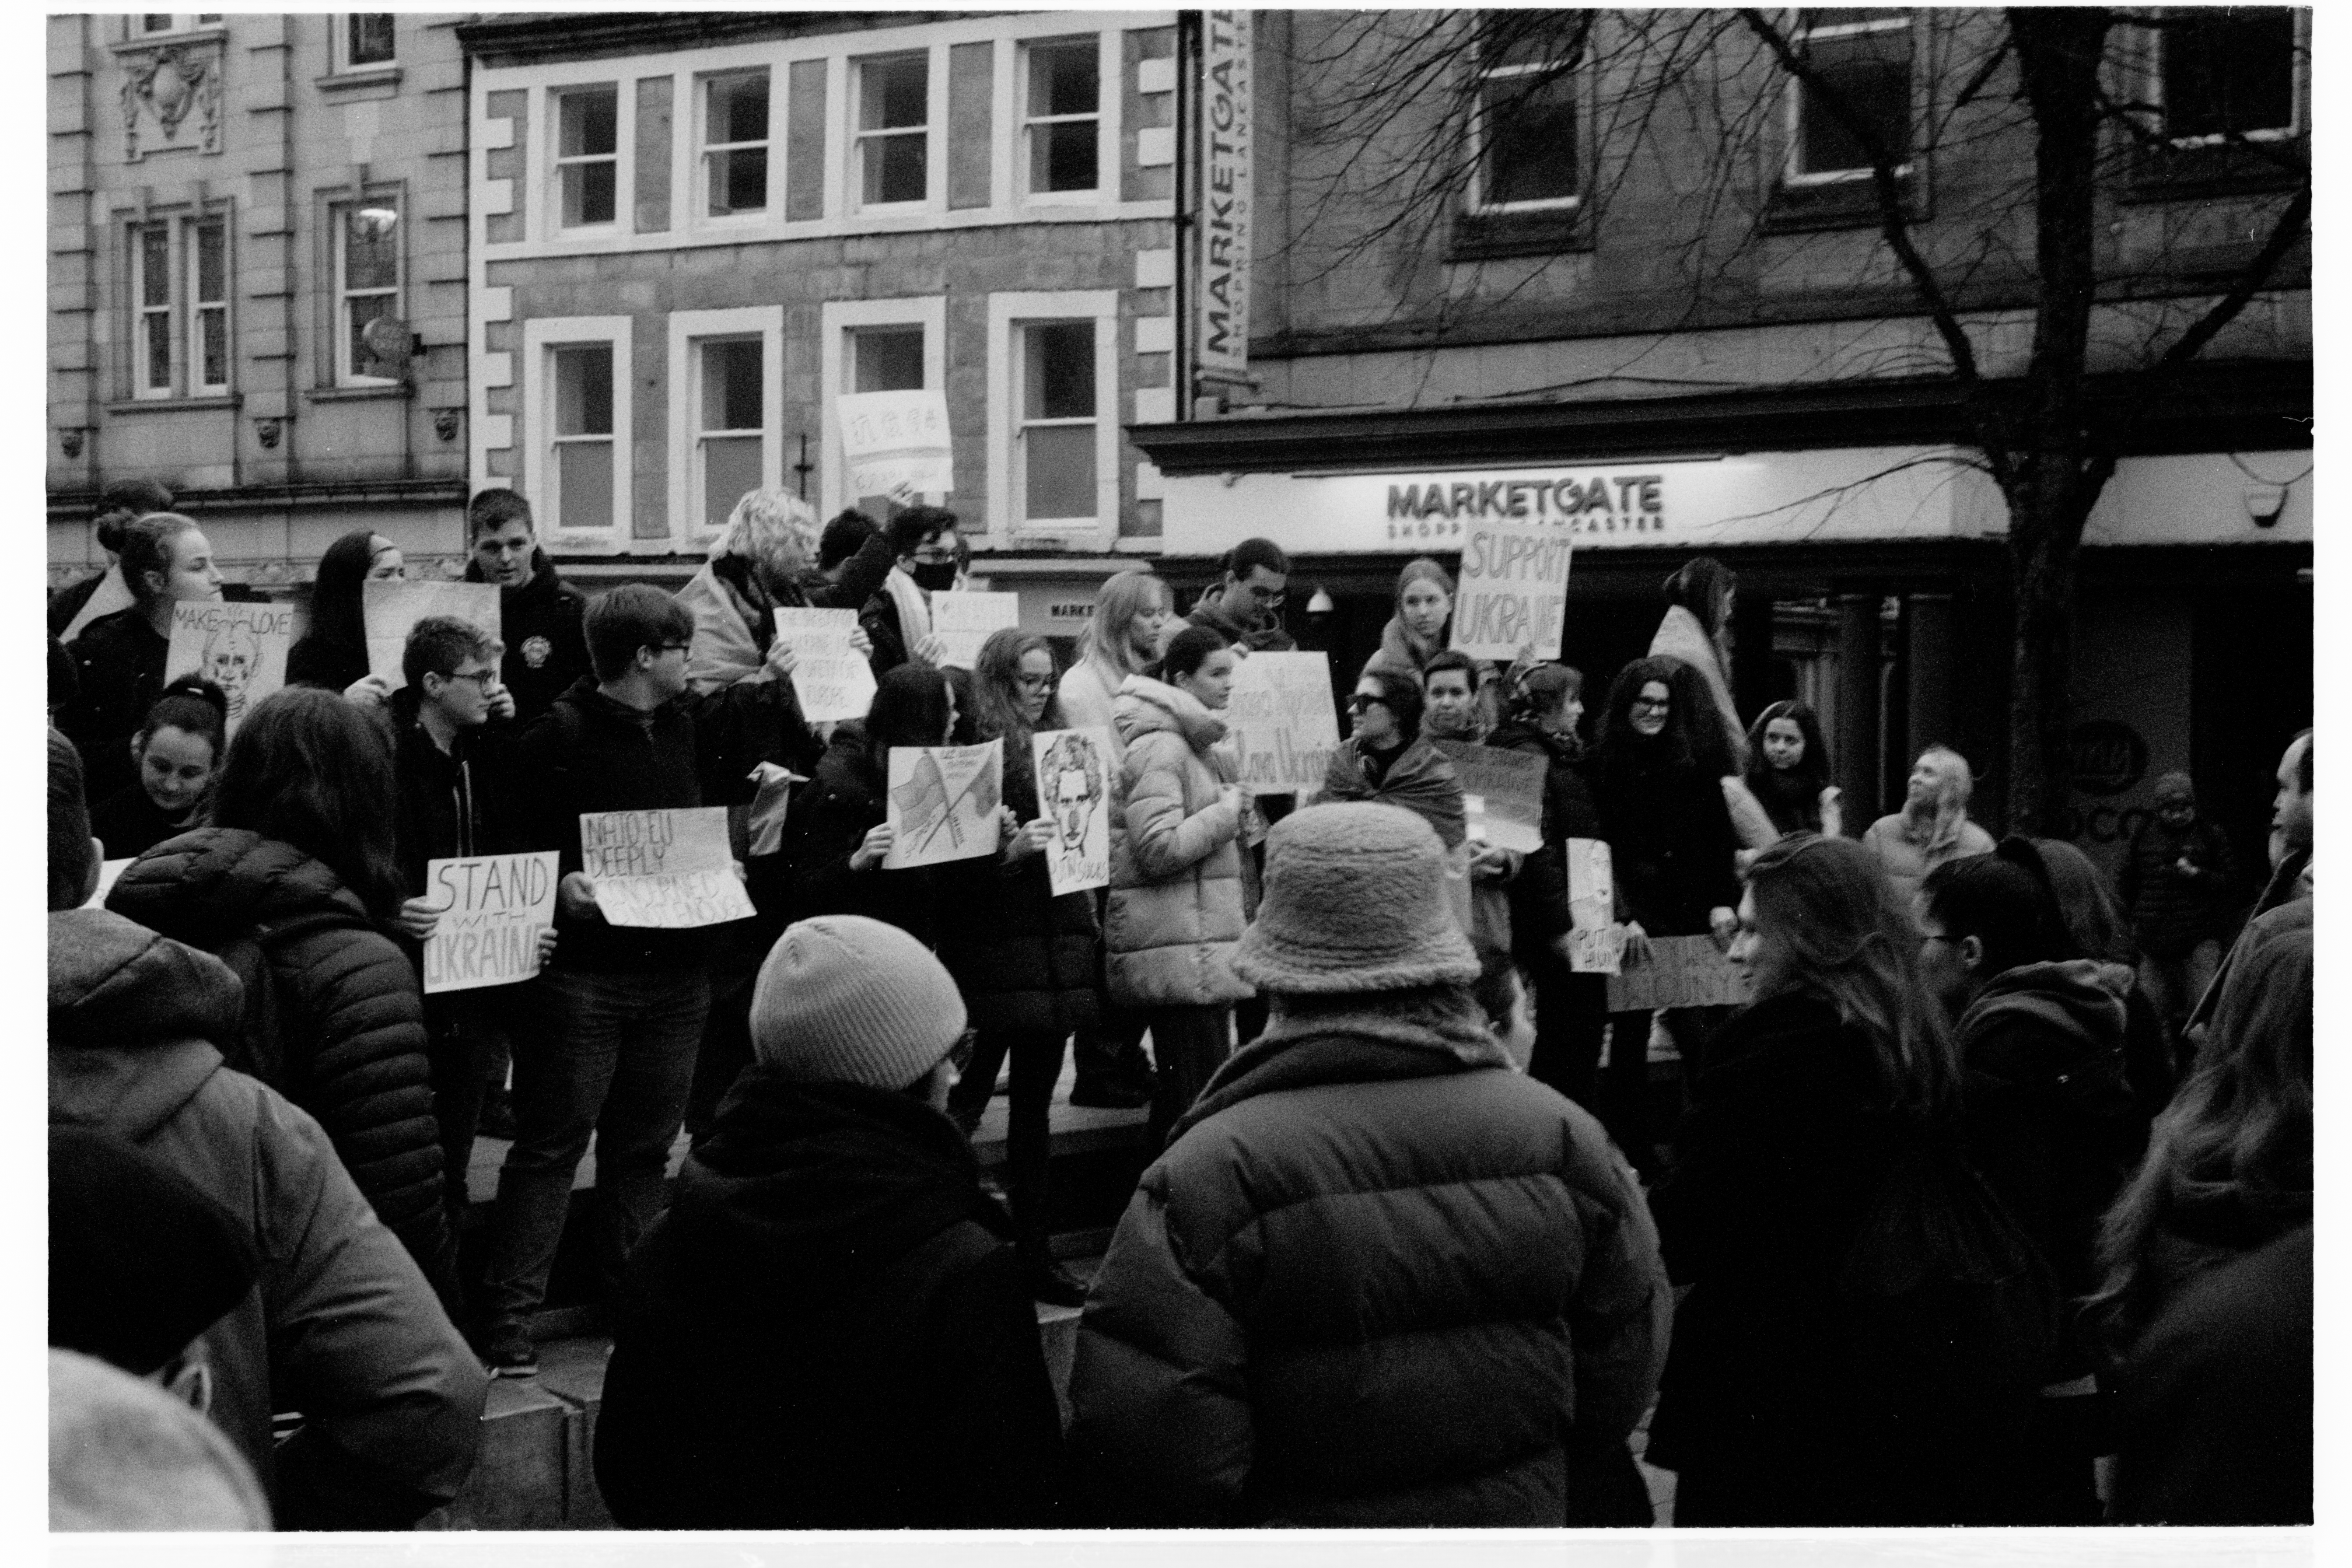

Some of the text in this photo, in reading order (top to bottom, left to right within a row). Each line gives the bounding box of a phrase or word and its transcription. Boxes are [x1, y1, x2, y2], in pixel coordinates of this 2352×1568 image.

[1207, 10, 1234, 355] MARKETGATE
[1233, 18, 1249, 357] SHOPPING LANCASTE
[1387, 475, 1663, 519] MARKETGATE
[1387, 516, 1664, 540] SHOPP CASTER
[1462, 531, 1570, 583] SUPPORT
[175, 608, 291, 635] MAKE LOVE
[1051, 605, 1094, 617] MARKE
[584, 844, 667, 878] DEEPLY
[438, 858, 548, 912] STAND
[453, 911, 525, 930] WITH
[426, 922, 549, 985] UKRAINE
